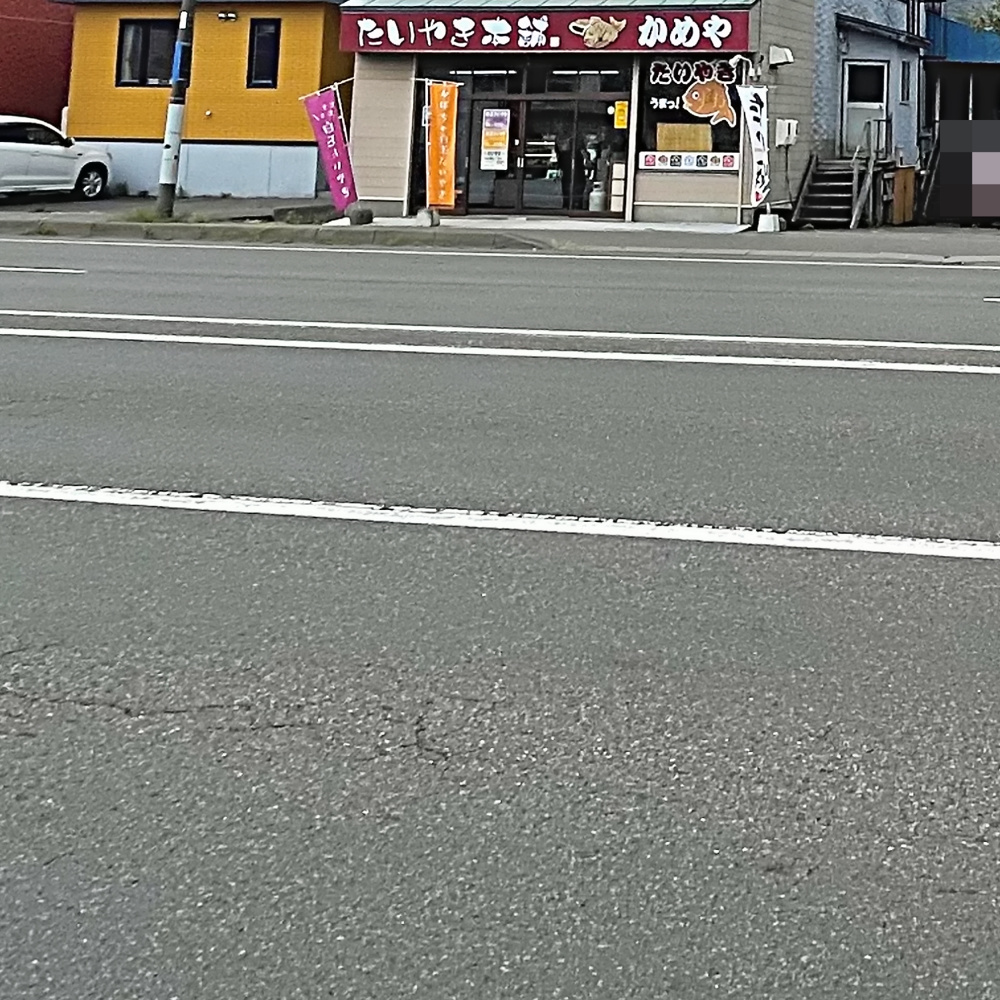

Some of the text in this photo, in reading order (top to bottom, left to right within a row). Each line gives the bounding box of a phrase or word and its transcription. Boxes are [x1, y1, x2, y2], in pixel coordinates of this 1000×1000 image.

[638, 14, 732, 49] かめや
[650, 60, 737, 85] たいやき
